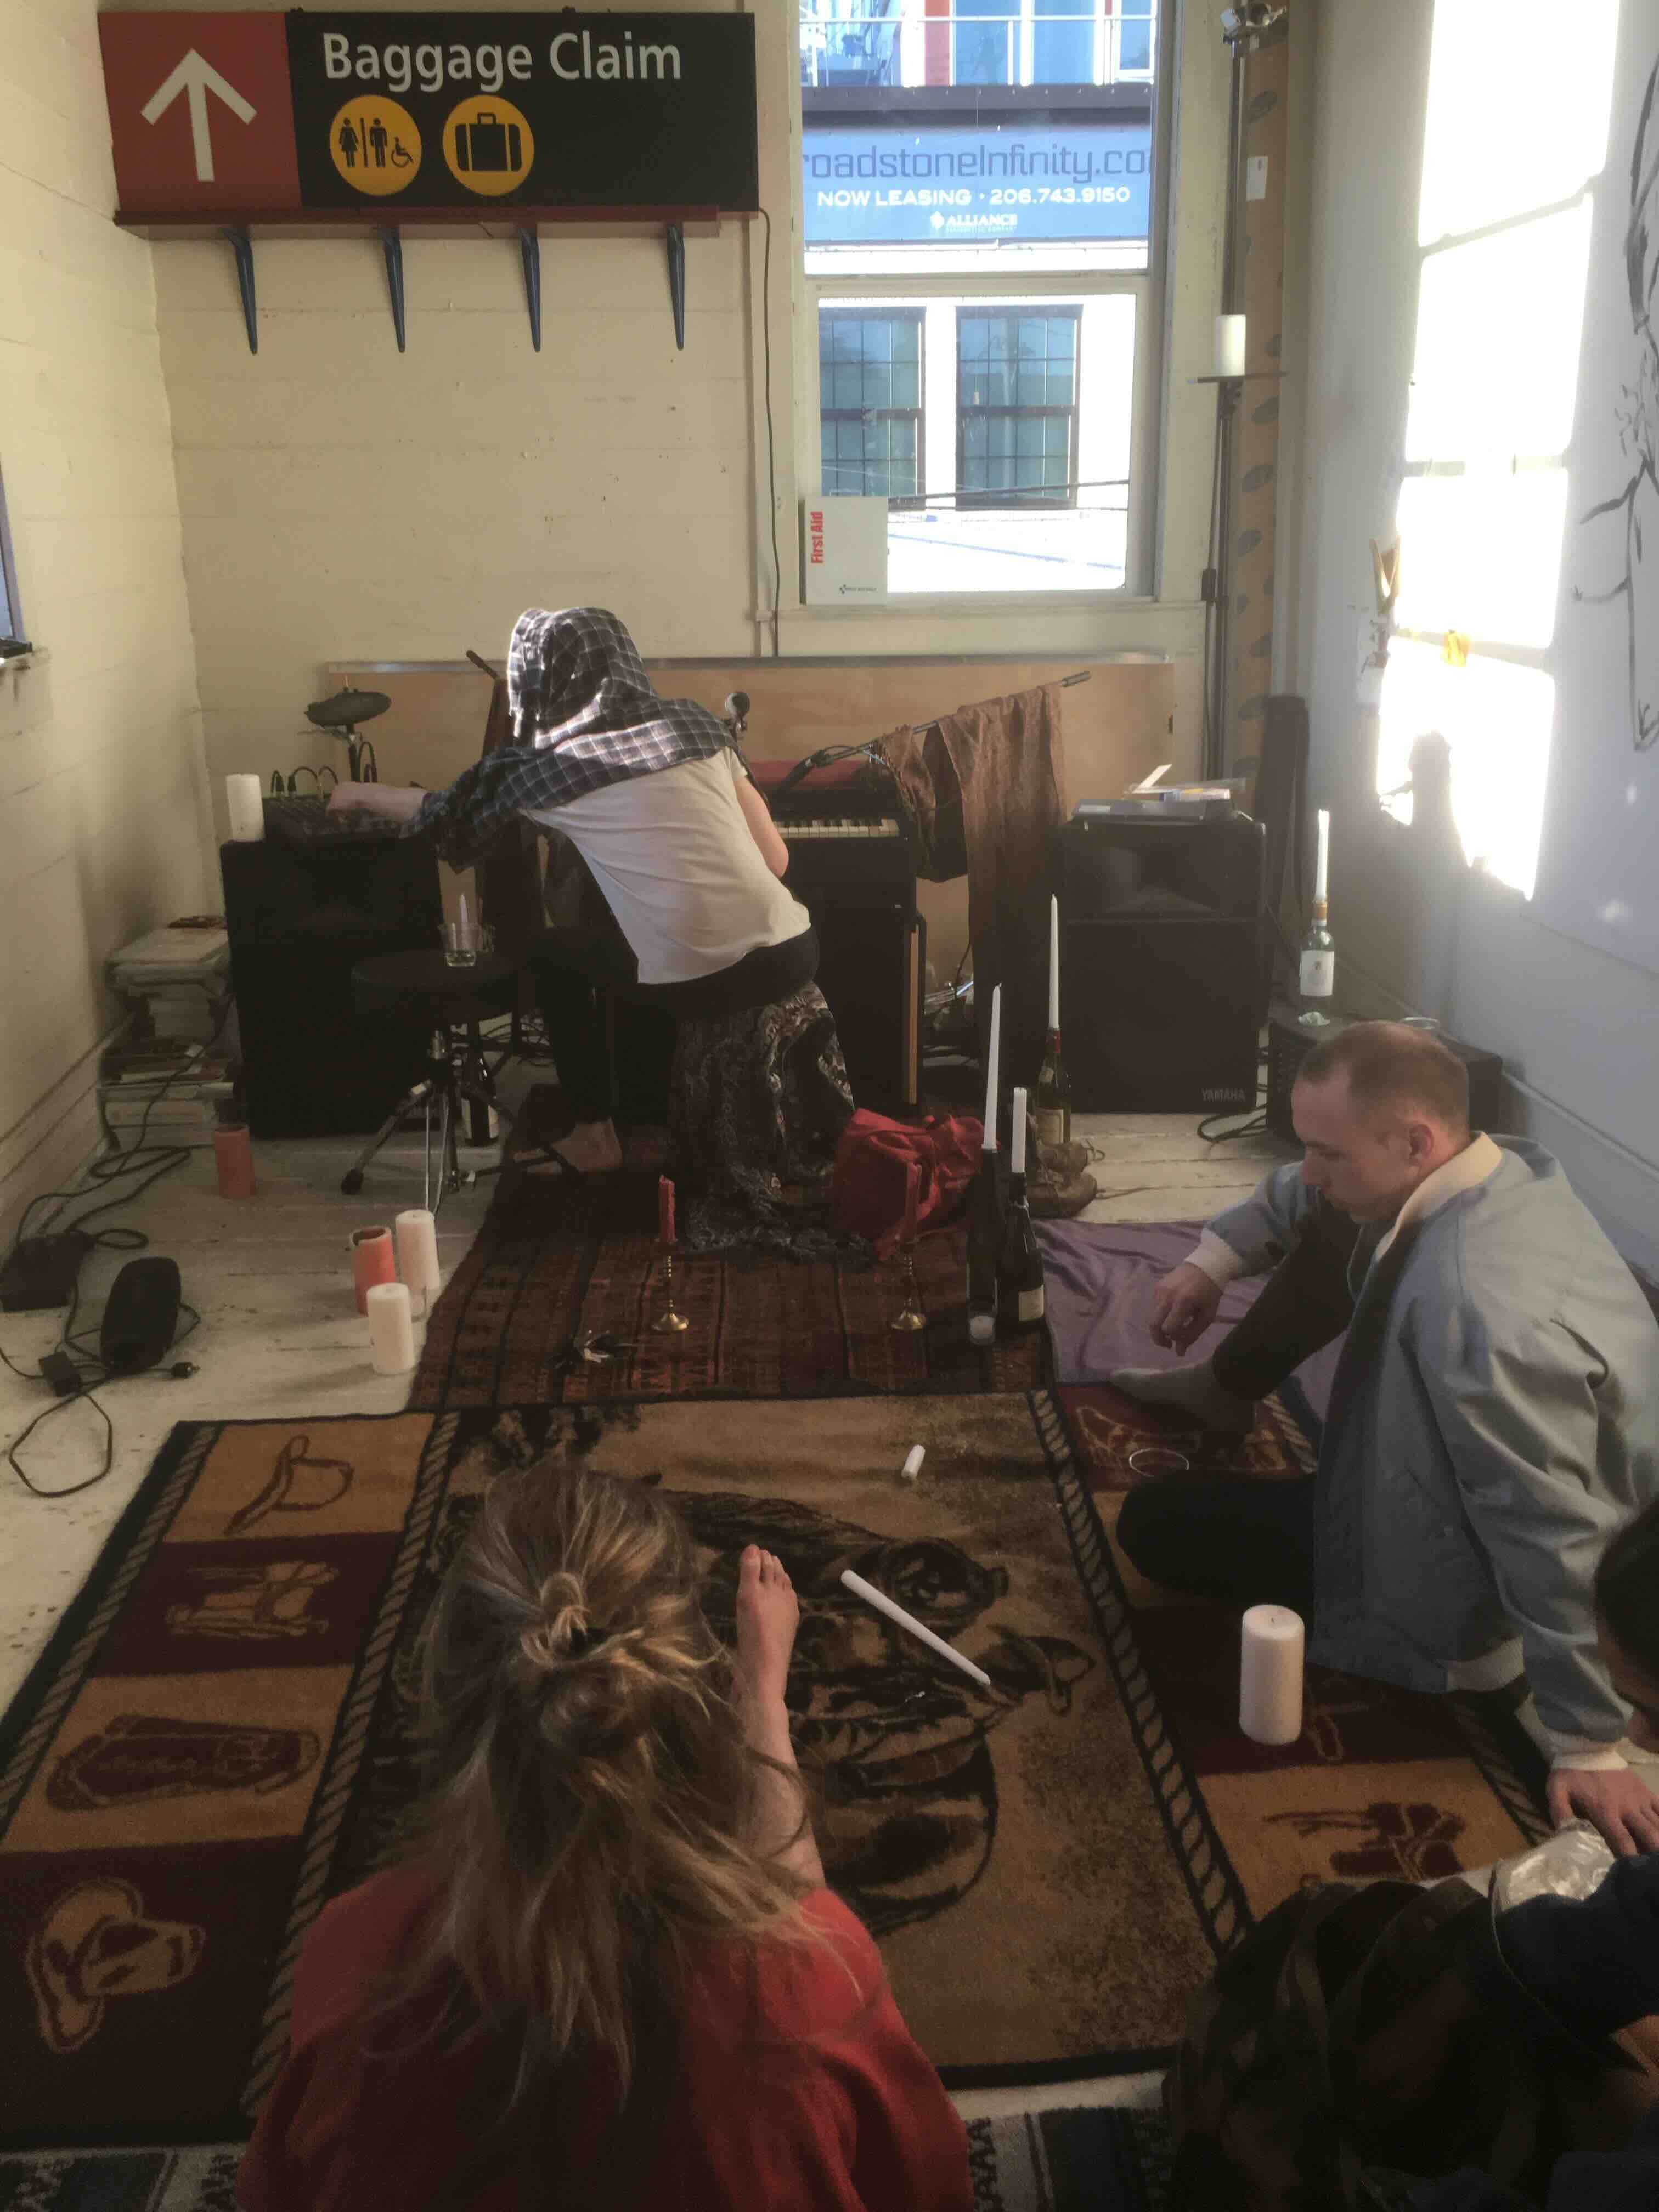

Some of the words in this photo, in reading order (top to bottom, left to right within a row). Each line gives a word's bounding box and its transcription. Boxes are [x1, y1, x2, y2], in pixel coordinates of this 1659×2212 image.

[323, 33, 533, 92] Baggage
[549, 30, 681, 80] Claim
[803, 144, 1150, 184] oadstoneInfinity.co
[817, 190, 871, 207] NOW
[875, 189, 972, 206] LEASING
[989, 187, 1130, 203] 206.743.9150
[947, 214, 1018, 227] ALLIANCE
[810, 512, 823, 532] Aid
[810, 535, 823, 563] First
[1201, 1088, 1247, 1102] YAMAHA
